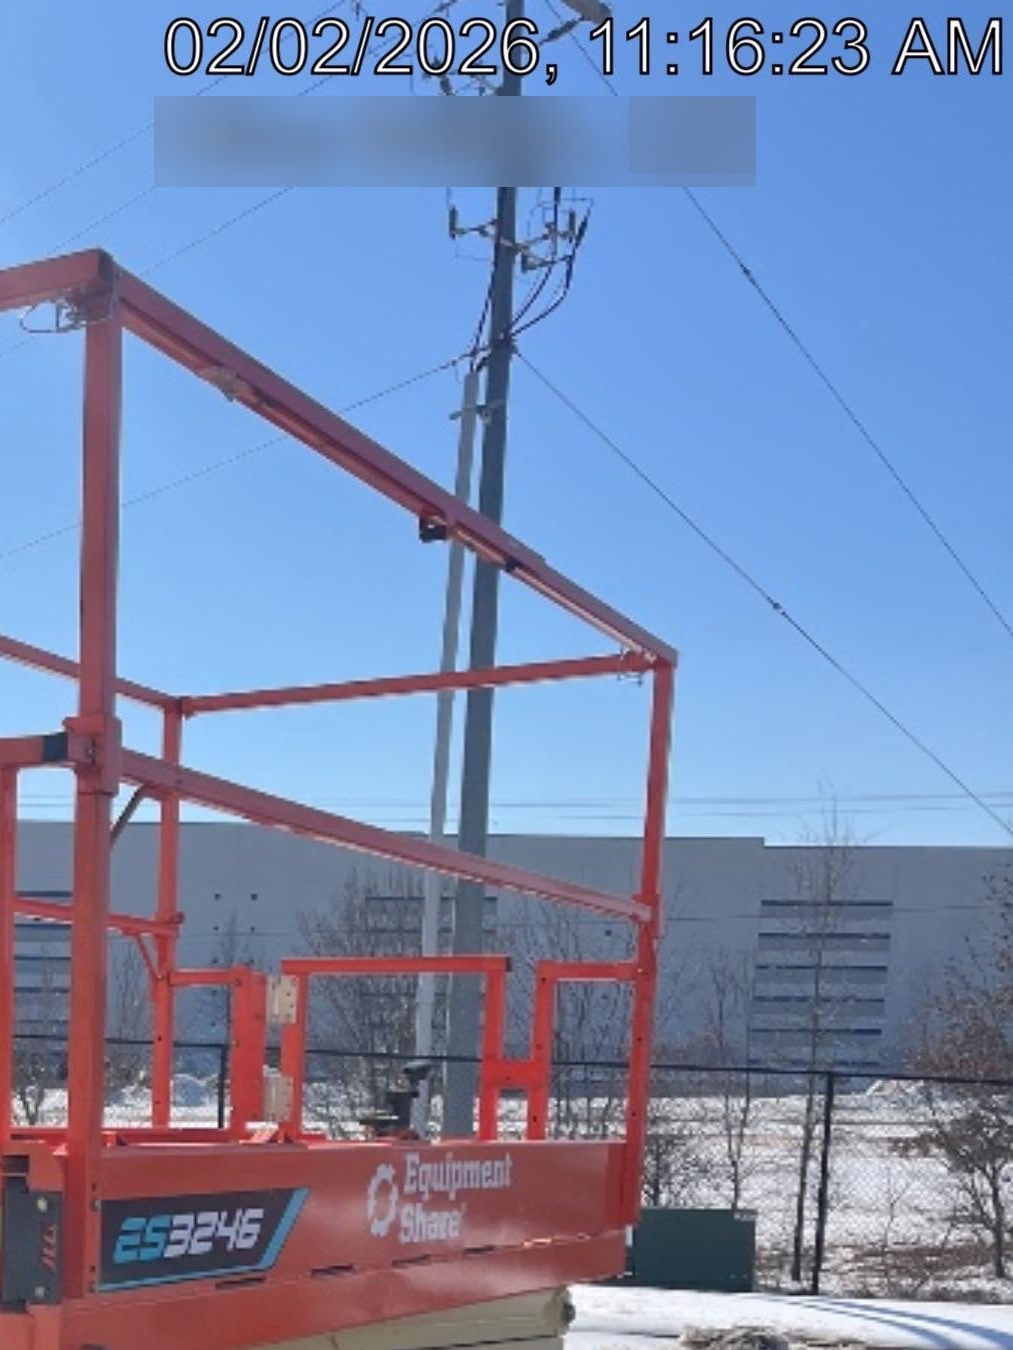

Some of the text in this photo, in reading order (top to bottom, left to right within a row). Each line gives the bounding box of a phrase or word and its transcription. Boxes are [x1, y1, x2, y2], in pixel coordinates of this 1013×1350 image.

[403, 1152, 512, 1200] Equipment
[113, 1208, 264, 1264] ES3246
[400, 1202, 462, 1244] Share
